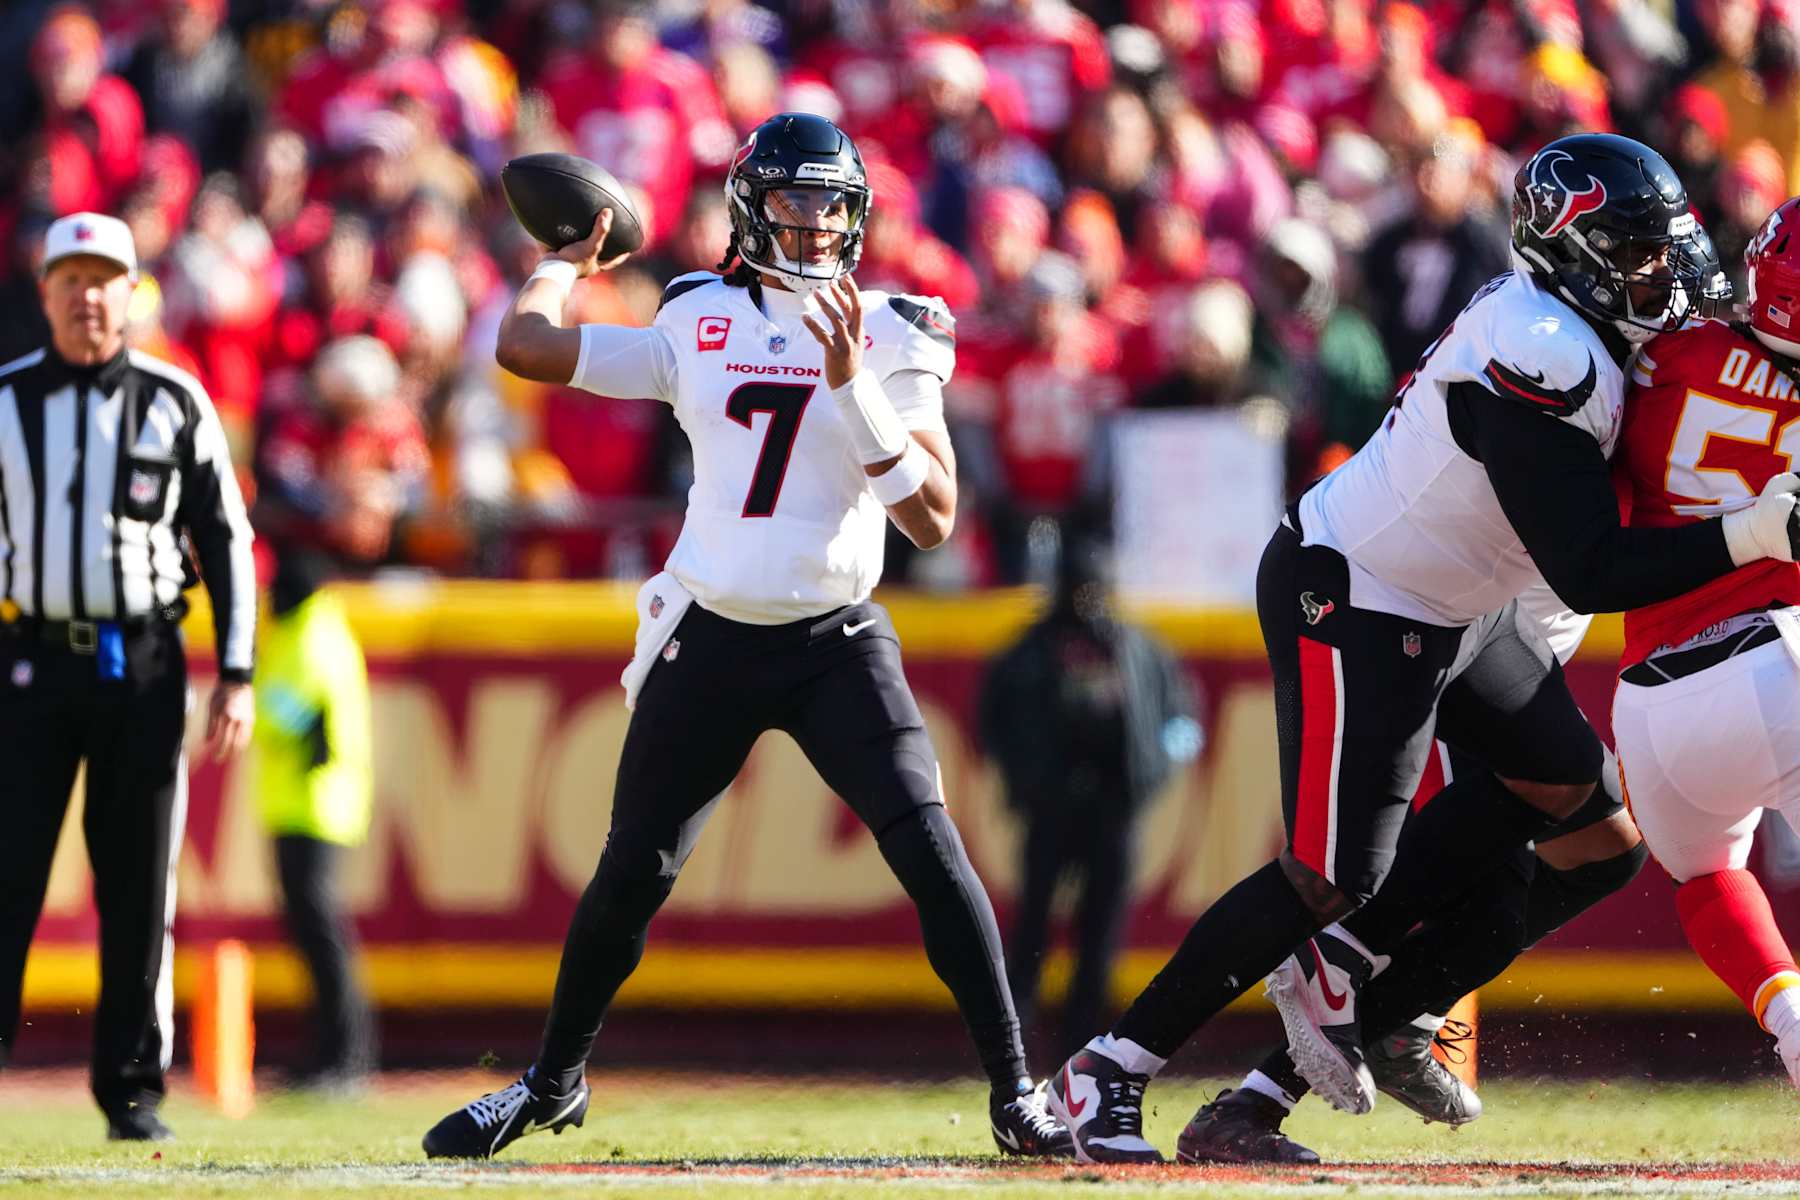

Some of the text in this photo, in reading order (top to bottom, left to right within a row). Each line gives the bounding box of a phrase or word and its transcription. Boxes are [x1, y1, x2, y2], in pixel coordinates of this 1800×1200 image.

[701, 321, 727, 343] C
[726, 363, 821, 378] HOUSTON
[725, 381, 817, 518] 7
